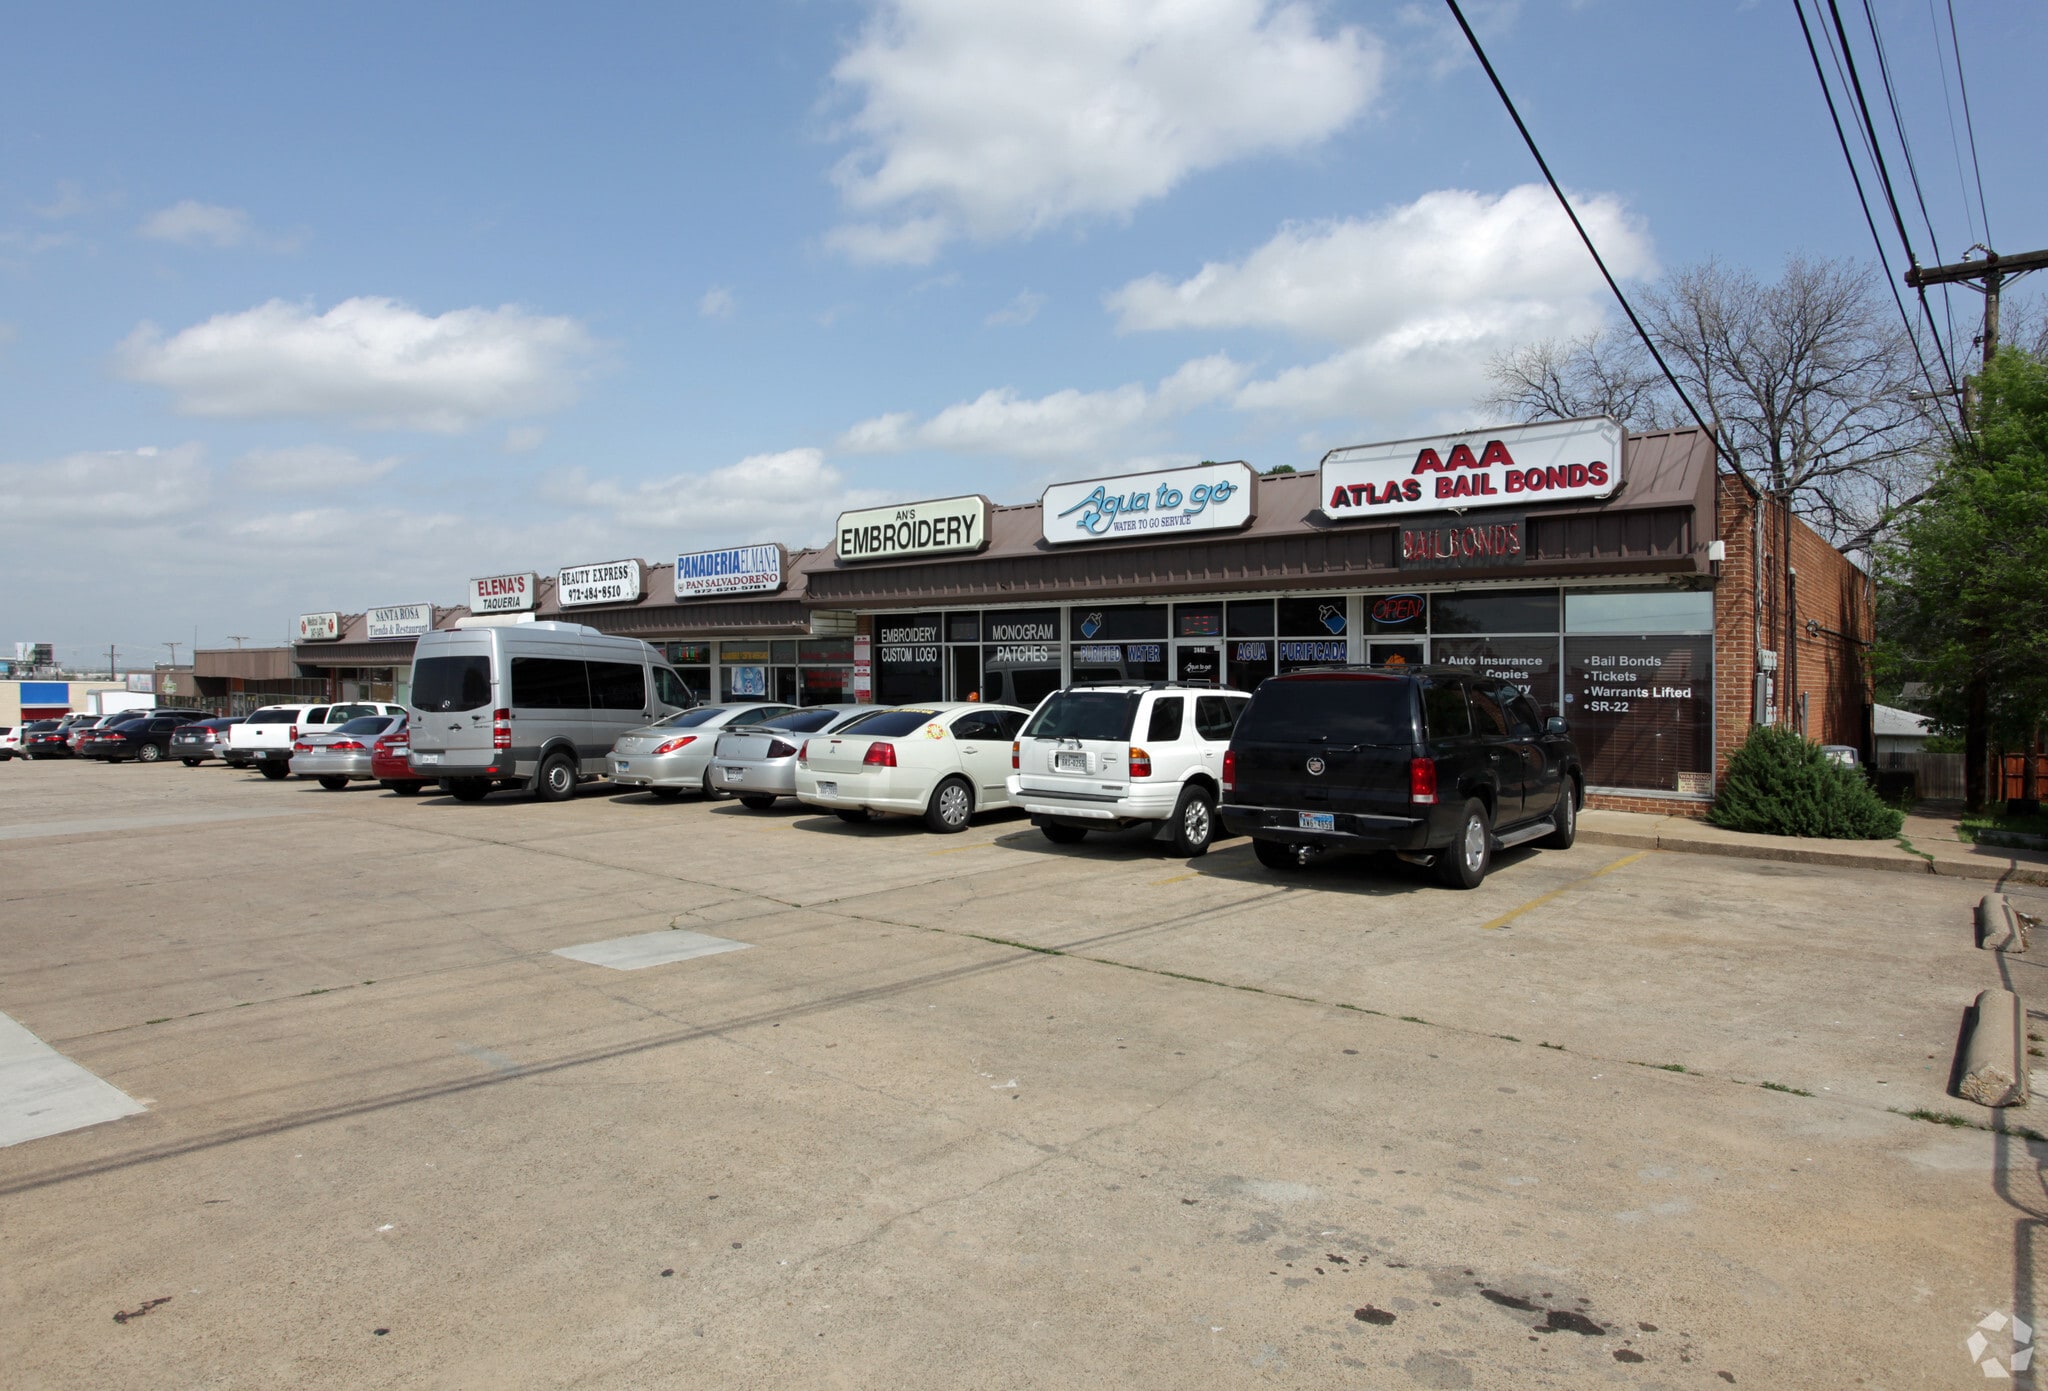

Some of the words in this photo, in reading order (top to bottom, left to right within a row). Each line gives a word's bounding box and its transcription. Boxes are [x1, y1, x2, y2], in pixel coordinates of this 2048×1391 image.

[1412, 440, 1514, 475] AAA
[1330, 478, 1422, 508] ATLAS
[1435, 473, 1498, 499] BAIL
[1505, 461, 1609, 493] BONDS
[896, 509, 916, 521] AN'S
[1058, 485, 1151, 535] Agua
[1155, 482, 1183, 509] to
[1183, 480, 1238, 514] go
[1113, 521, 1137, 532] WATER
[1138, 520, 1148, 529] TO
[1149, 518, 1160, 528] GO
[1161, 514, 1192, 528] SERVICE
[841, 513, 977, 555] EMBROIDERY
[1403, 529, 1441, 561] BAIL
[1450, 523, 1521, 558] BONDS
[677, 550, 741, 580] PANADERIA
[561, 569, 590, 586] BEAUTY
[592, 565, 629, 583] EXPRESS
[686, 580, 704, 590] PAN
[705, 572, 778, 588] SALVADOREÑO
[477, 576, 526, 597] ELENA'S
[568, 585, 622, 601] 972-484-8510
[483, 597, 521, 609] TAQUERIA
[1373, 599, 1421, 619] OPEN
[375, 610, 399, 621] SANTA
[399, 607, 420, 619] ROSA
[369, 625, 389, 636] Tienda
[395, 624, 428, 634] Restaurant
[881, 627, 937, 643] EMBROIDERY
[992, 624, 1054, 640] MONOGRAM
[881, 647, 913, 662] CUSTOM
[915, 647, 937, 662] LOGO
[997, 646, 1048, 662] PATCHES
[1080, 645, 1122, 662] PURIFIED
[1127, 645, 1160, 662] WATER
[1236, 642, 1267, 661] AGUA
[1280, 641, 1347, 661] PURIFICADA
[1447, 656, 1475, 666] Auto
[1479, 656, 1543, 666] Insurance
[1591, 656, 1616, 667] Bail
[1620, 656, 1662, 667] Bonds
[1486, 669, 1529, 680] Copies
[1591, 671, 1637, 682] Tickets
[1591, 686, 1649, 698] Warrants
[1652, 686, 1692, 699] Lifted
[1591, 701, 1629, 712] SR-22
